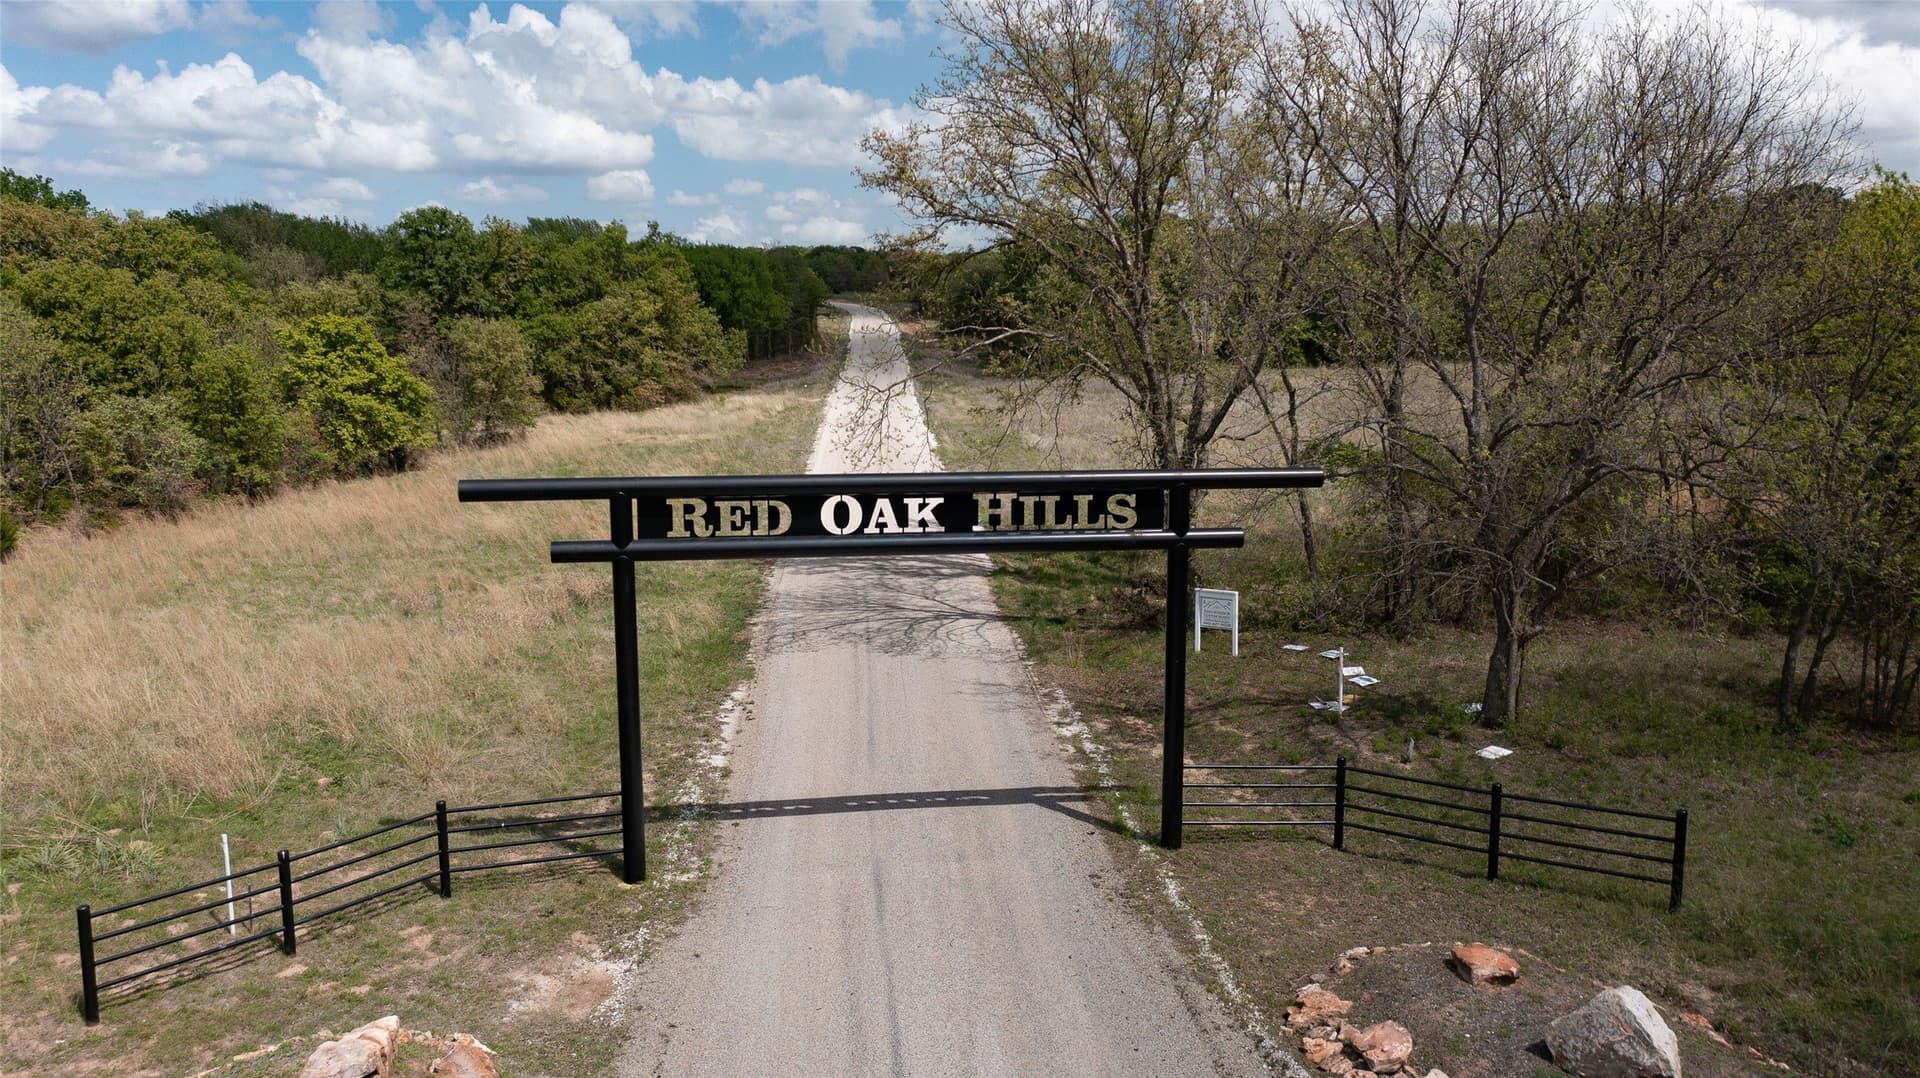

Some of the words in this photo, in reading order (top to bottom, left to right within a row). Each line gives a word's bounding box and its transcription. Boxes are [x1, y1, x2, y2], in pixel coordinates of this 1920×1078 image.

[666, 497, 792, 538] RED
[820, 494, 945, 535] OAK
[972, 492, 1138, 532] HILLS
